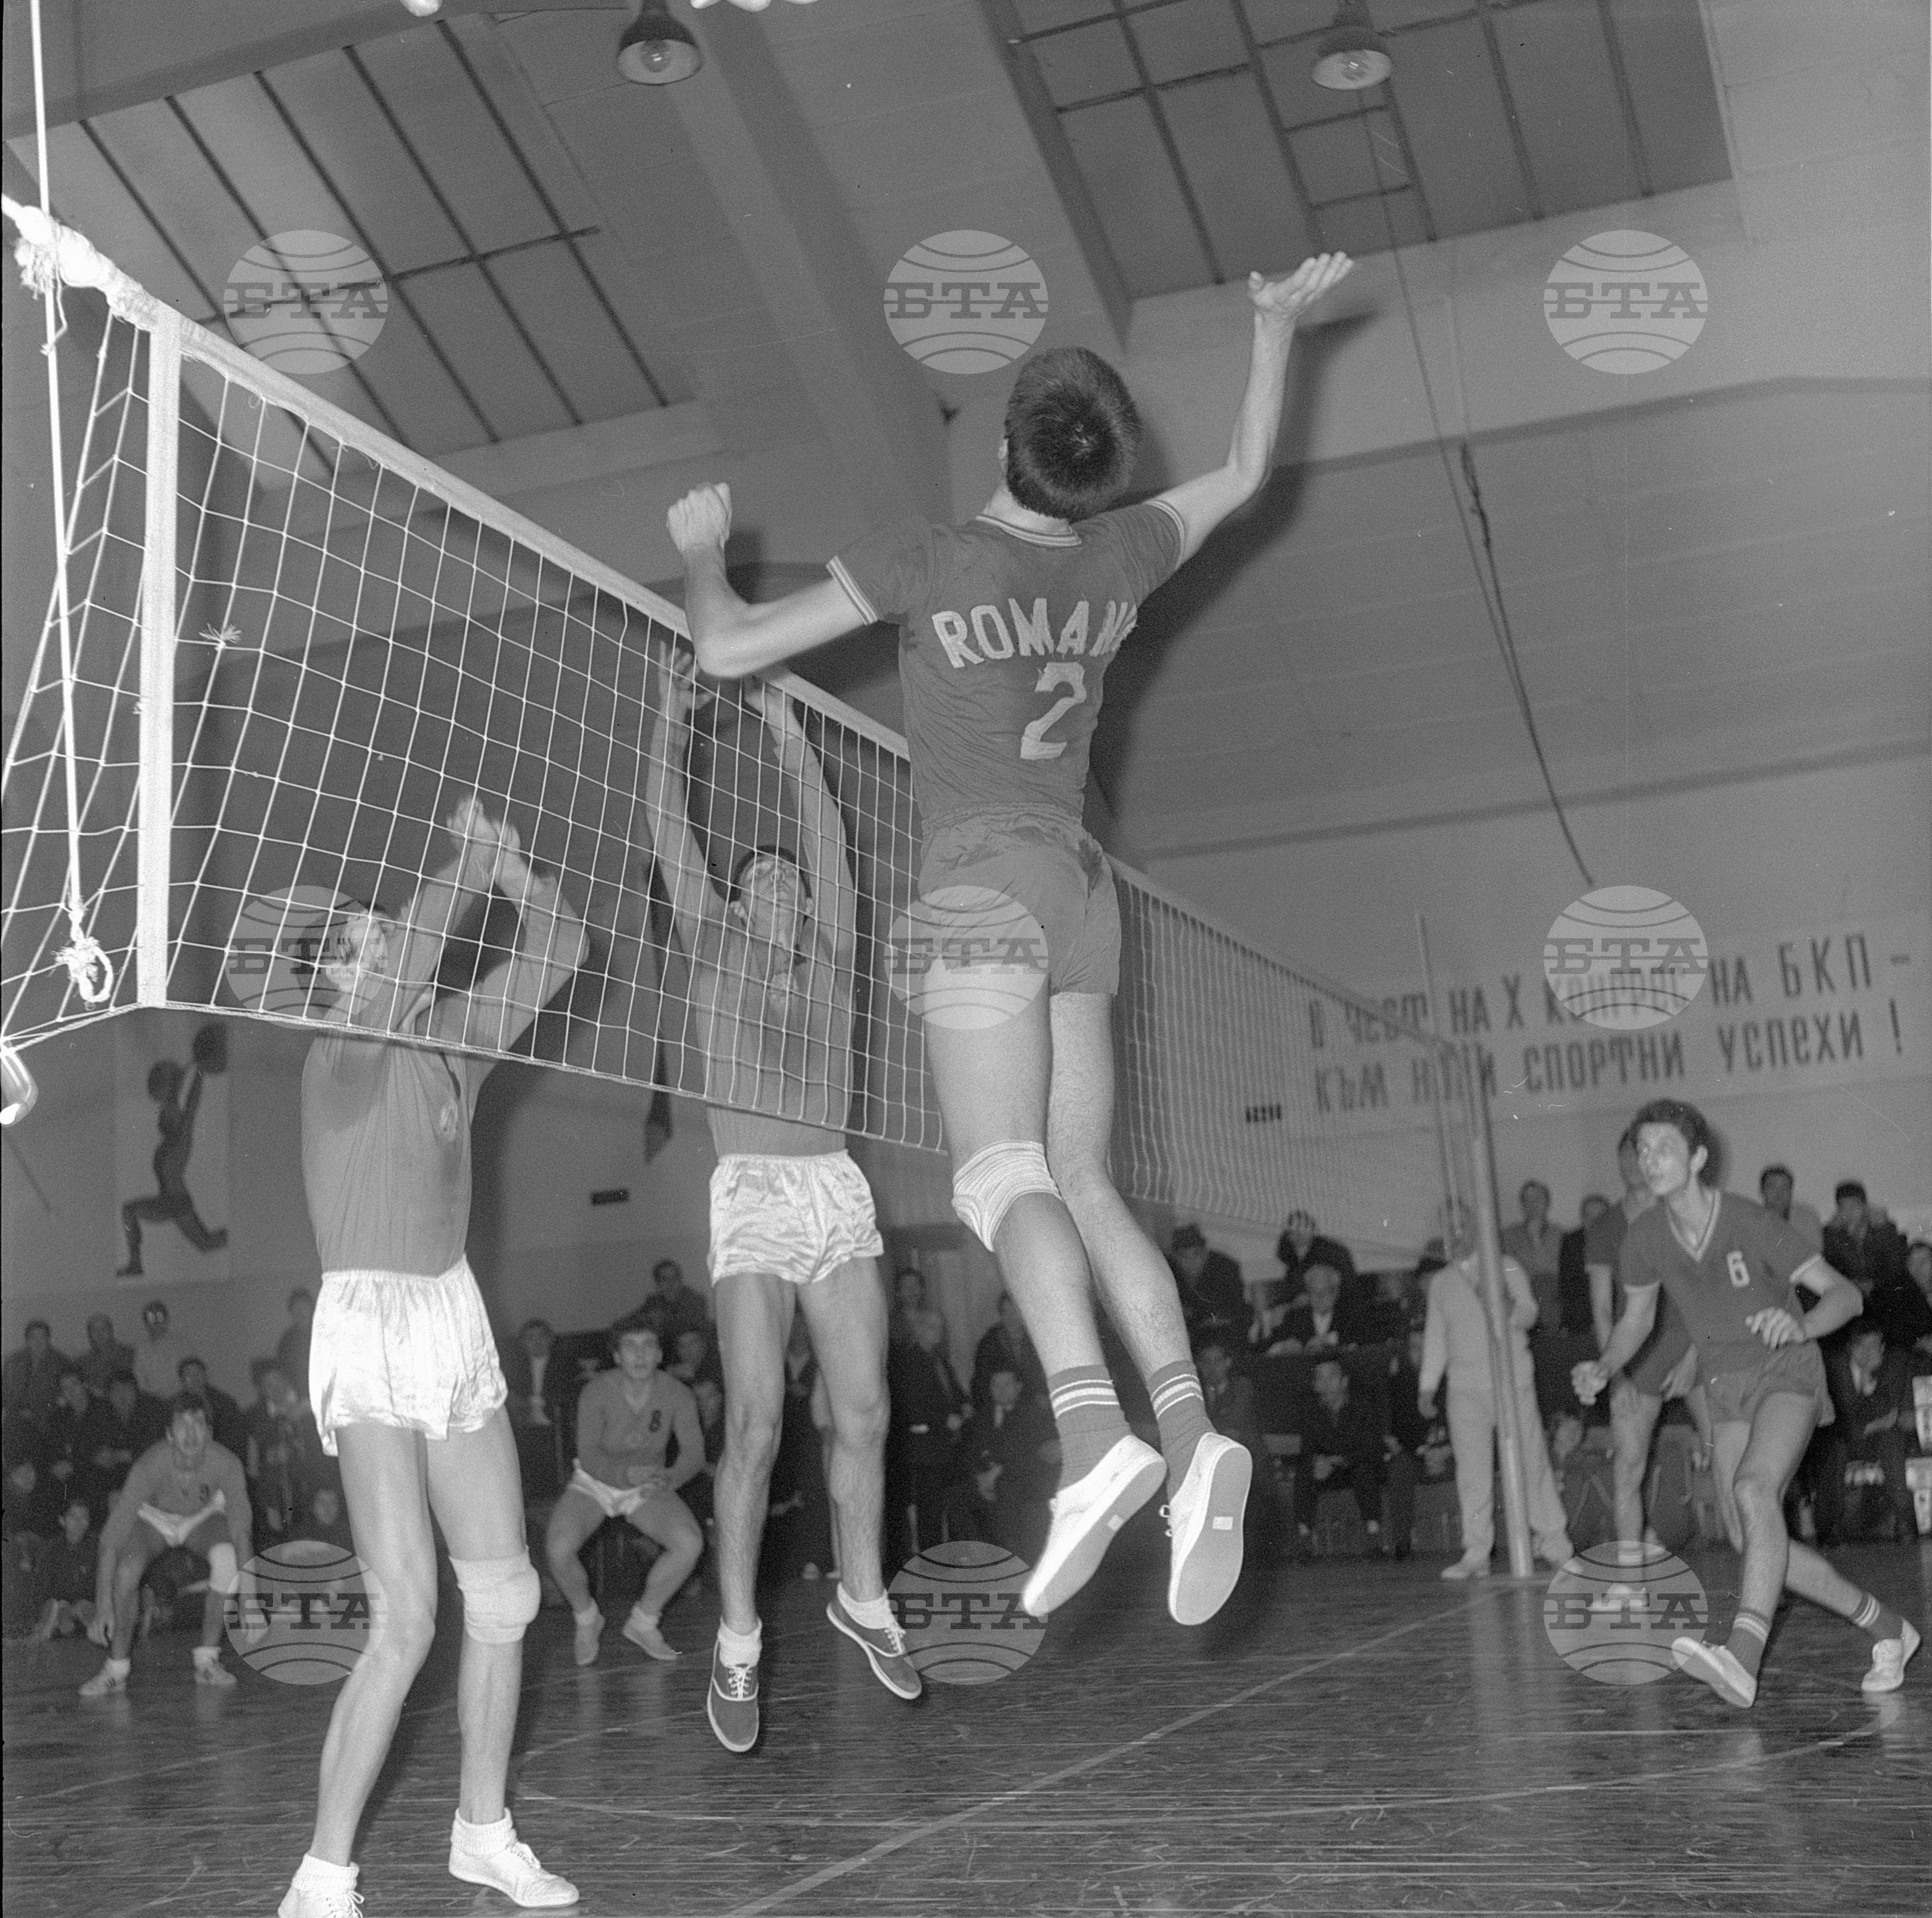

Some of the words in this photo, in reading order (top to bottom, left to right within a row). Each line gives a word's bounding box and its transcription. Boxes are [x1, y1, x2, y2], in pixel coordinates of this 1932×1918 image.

[1020, 661, 1087, 760] 2
[1450, 986, 1492, 1034] НА
[1707, 955, 1754, 1006] НА
[1777, 932, 1872, 999] БКП
[1523, 1029, 1686, 1094] СПОРТНИ
[1717, 1008, 1864, 1074] УСПЕХИ
[1727, 1250, 1750, 1287] 6
[648, 1409, 662, 1432] 8
